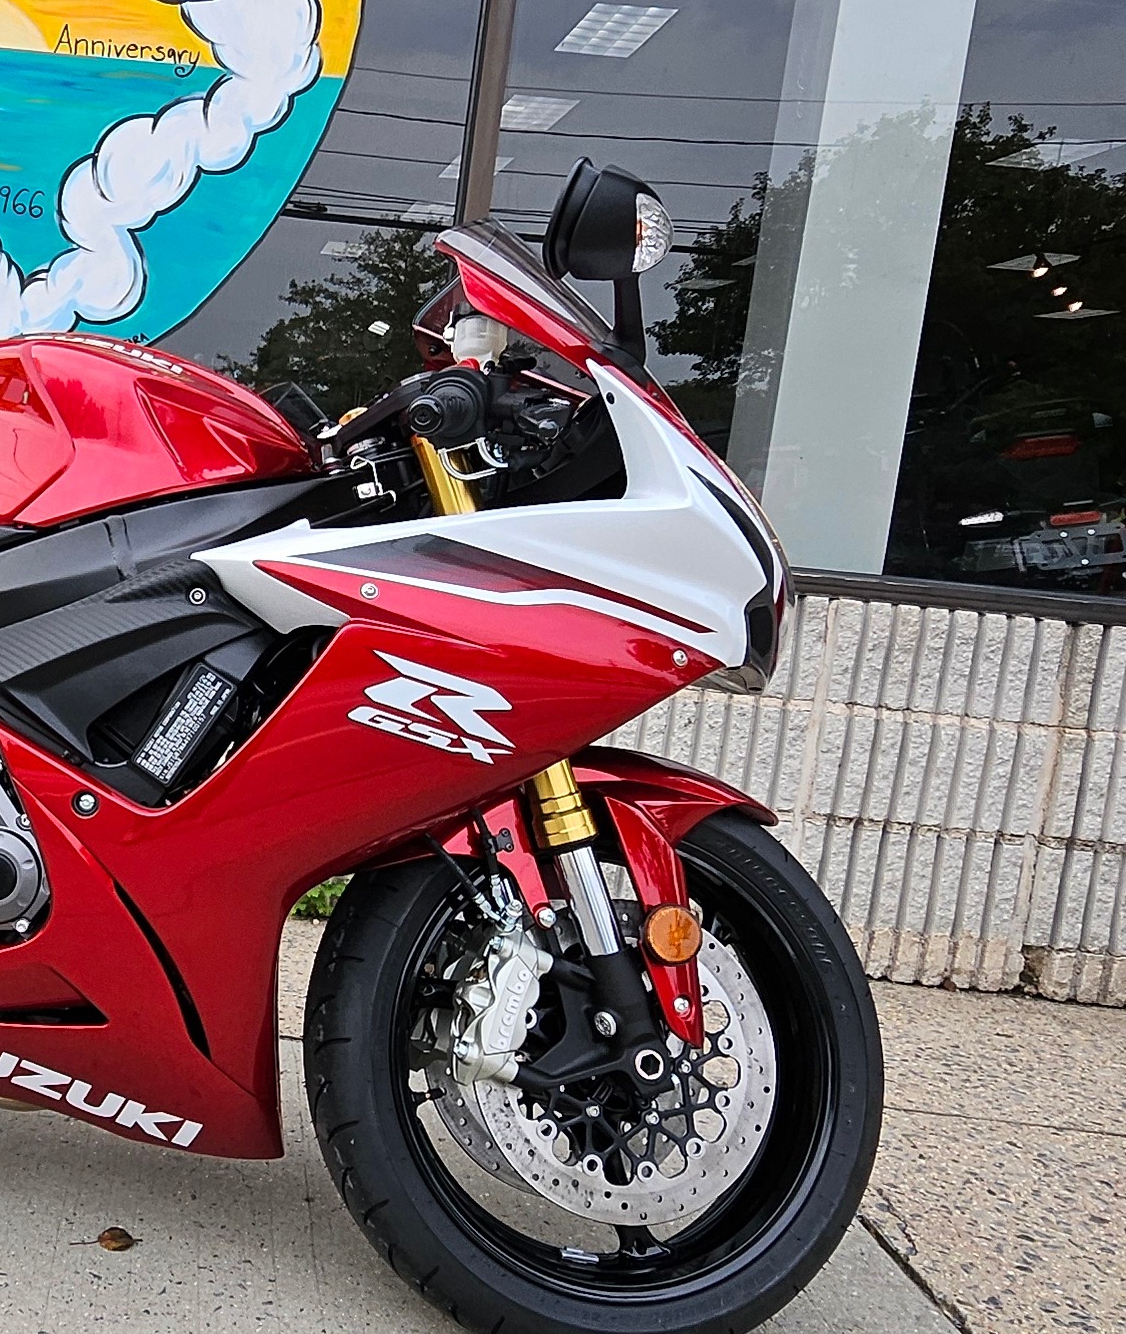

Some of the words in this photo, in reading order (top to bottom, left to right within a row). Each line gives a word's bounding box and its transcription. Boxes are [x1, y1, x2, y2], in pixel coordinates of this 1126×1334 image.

[53, 23, 201, 78] Anniversary
[363, 649, 517, 749] R
[347, 705, 514, 765] GSX
[489, 969, 531, 1051] brembo
